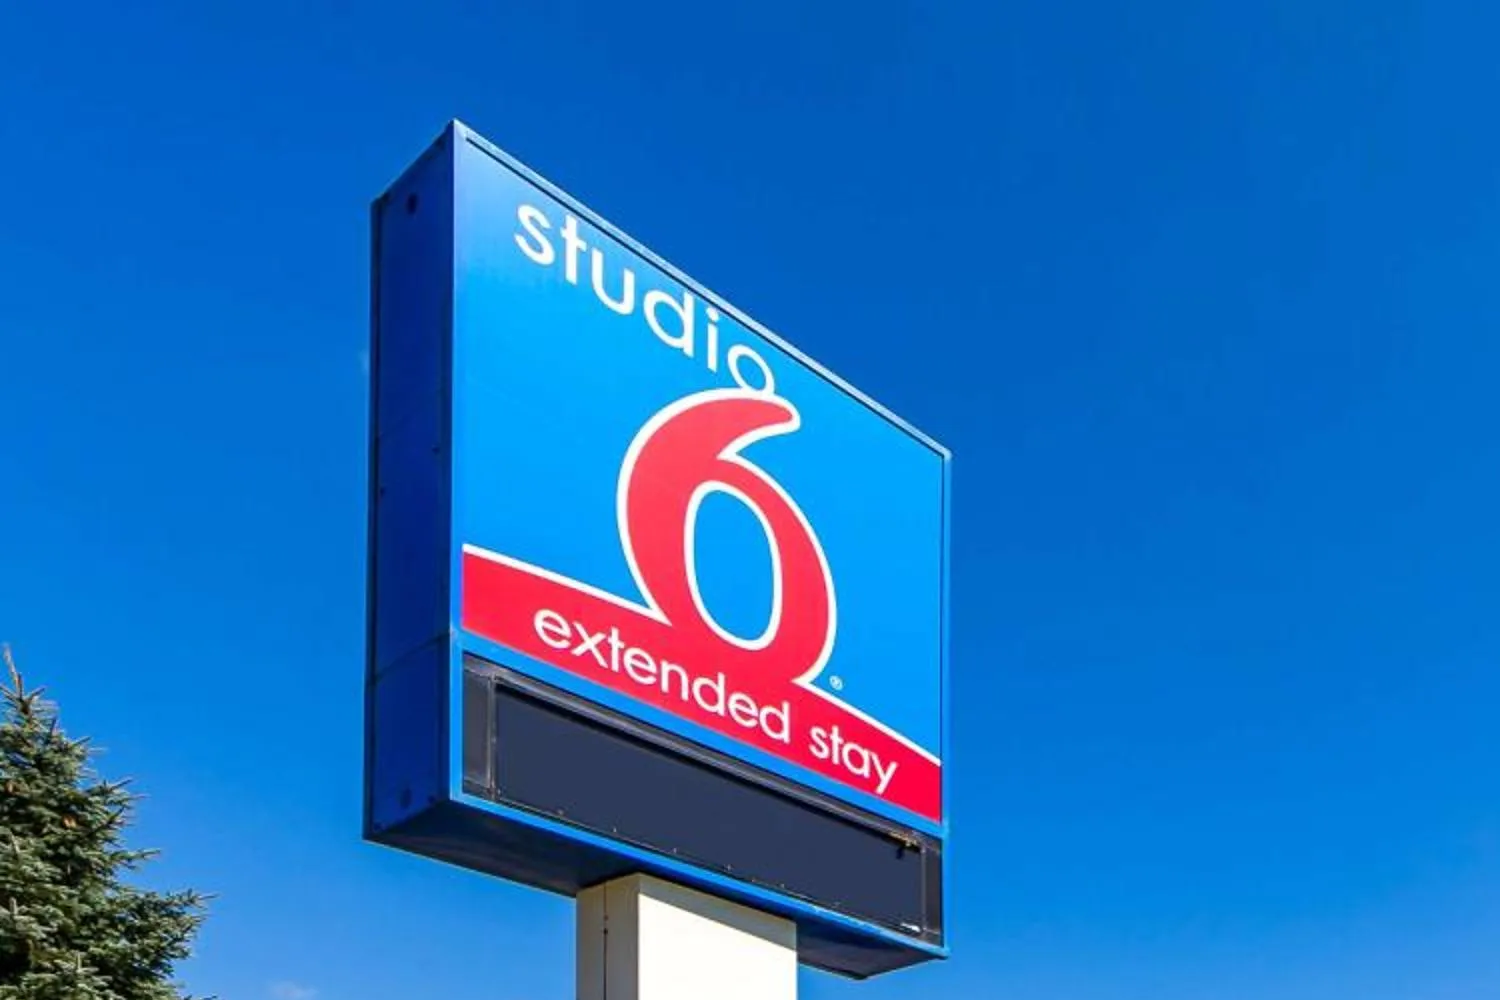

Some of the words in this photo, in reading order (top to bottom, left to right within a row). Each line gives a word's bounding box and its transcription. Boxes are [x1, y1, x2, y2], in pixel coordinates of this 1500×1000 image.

[514, 203, 776, 397] studio
[616, 386, 838, 690] 6
[534, 607, 792, 745] extended
[808, 723, 899, 796] stay
